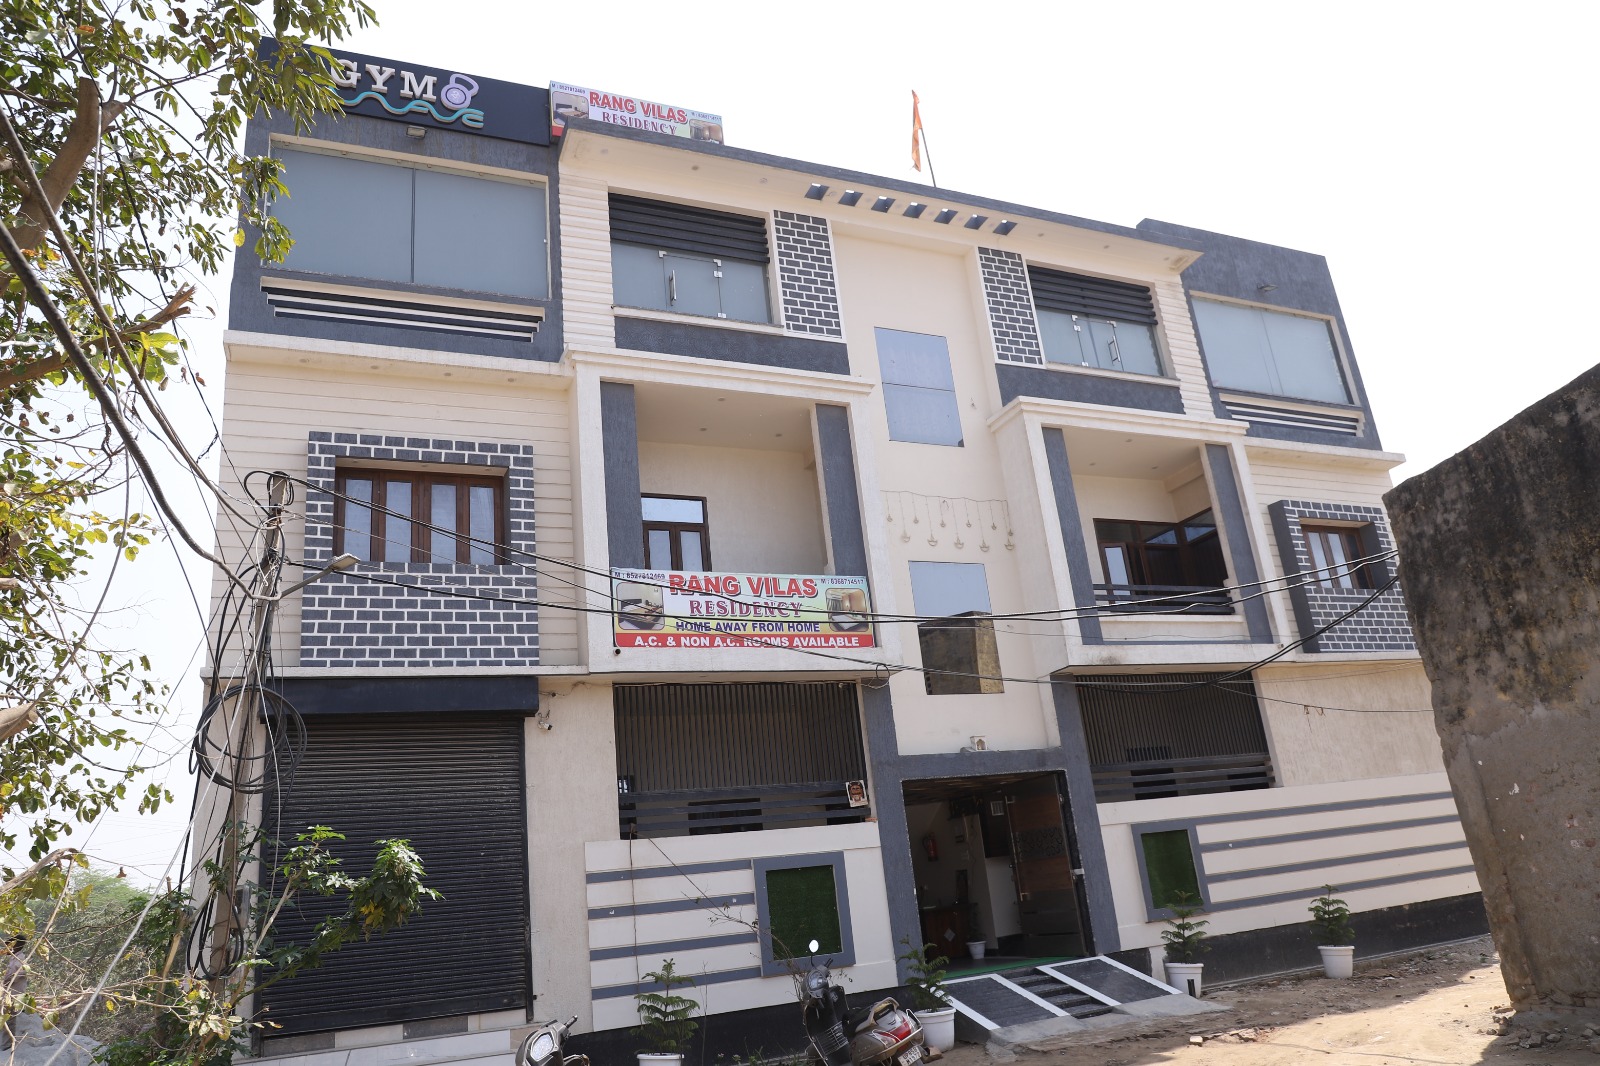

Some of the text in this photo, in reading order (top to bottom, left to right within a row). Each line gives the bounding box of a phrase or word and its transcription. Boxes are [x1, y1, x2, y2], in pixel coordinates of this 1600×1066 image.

[330, 59, 437, 103] GYM
[589, 91, 637, 115] RANG
[640, 101, 688, 125] VILAS
[602, 111, 677, 136] RESIDENCY
[669, 574, 819, 598] RANG VILAS
[689, 600, 802, 618] RESIDENCY
[676, 621, 820, 632] HOME AWAY FROM HOME
[634, 636, 860, 647] A.C. & NON A.C. ROOMS AVAILABLE
